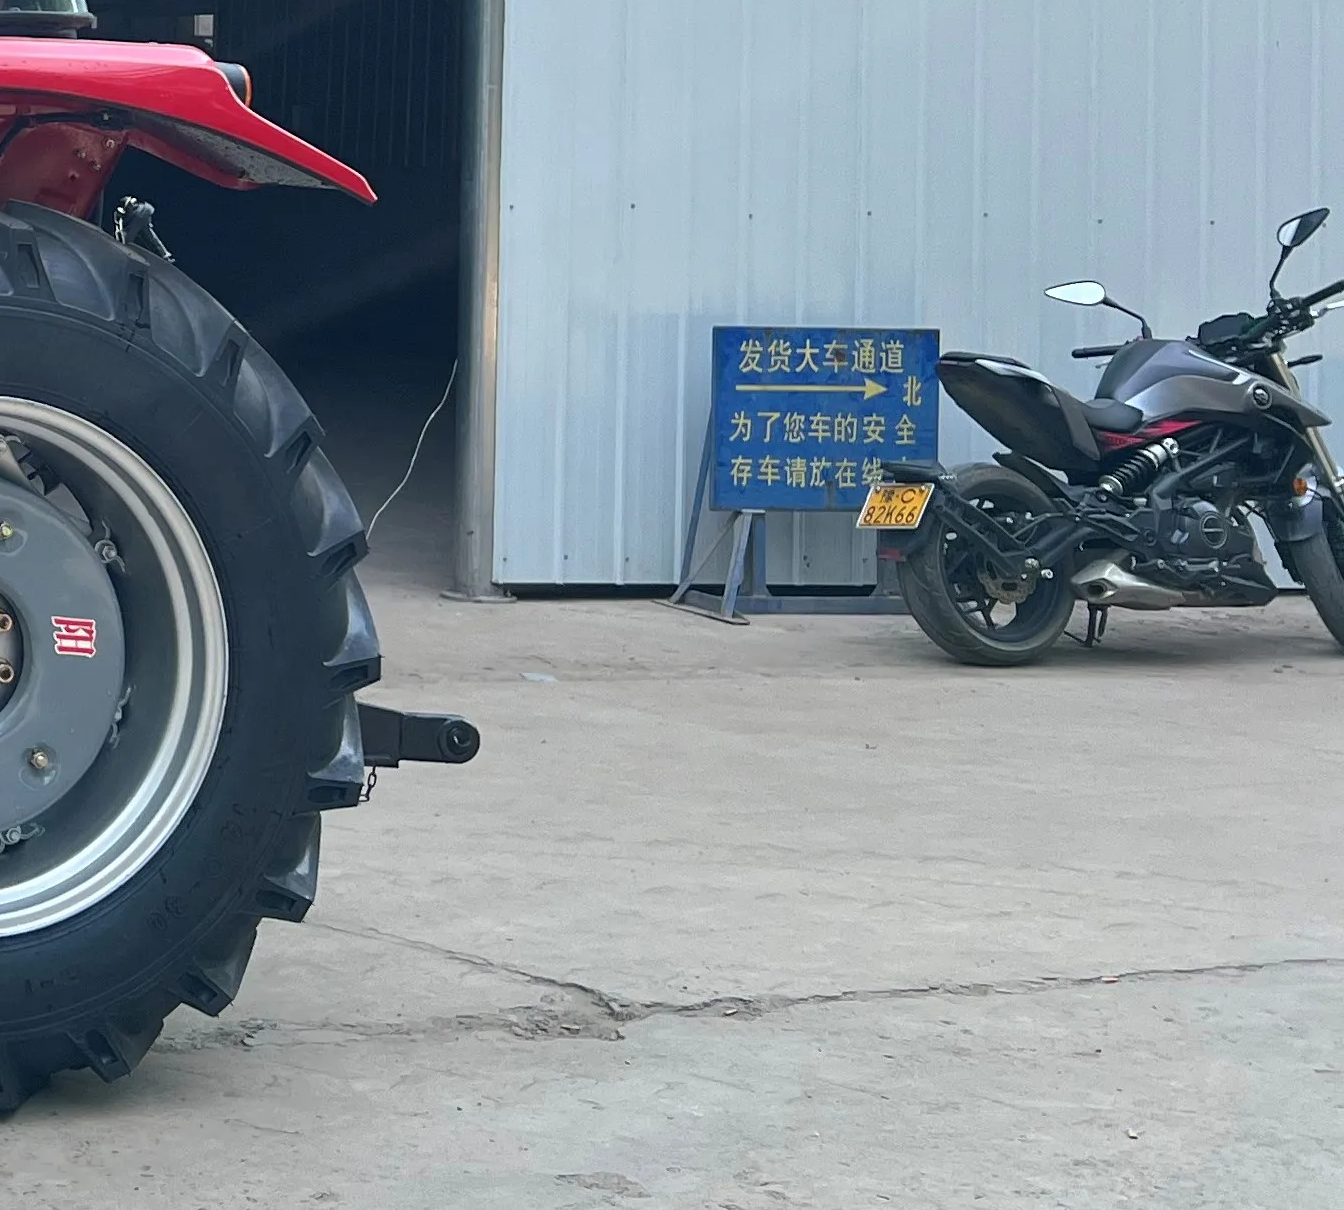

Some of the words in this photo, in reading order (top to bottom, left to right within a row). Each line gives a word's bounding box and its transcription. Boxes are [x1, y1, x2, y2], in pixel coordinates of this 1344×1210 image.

[739, 338, 905, 374] 发货大车通道
[902, 375, 922, 407] 北
[729, 410, 917, 446] 为了您车的安全
[730, 454, 906, 488] 存车请放在线
[863, 505, 918, 524] 82K66
